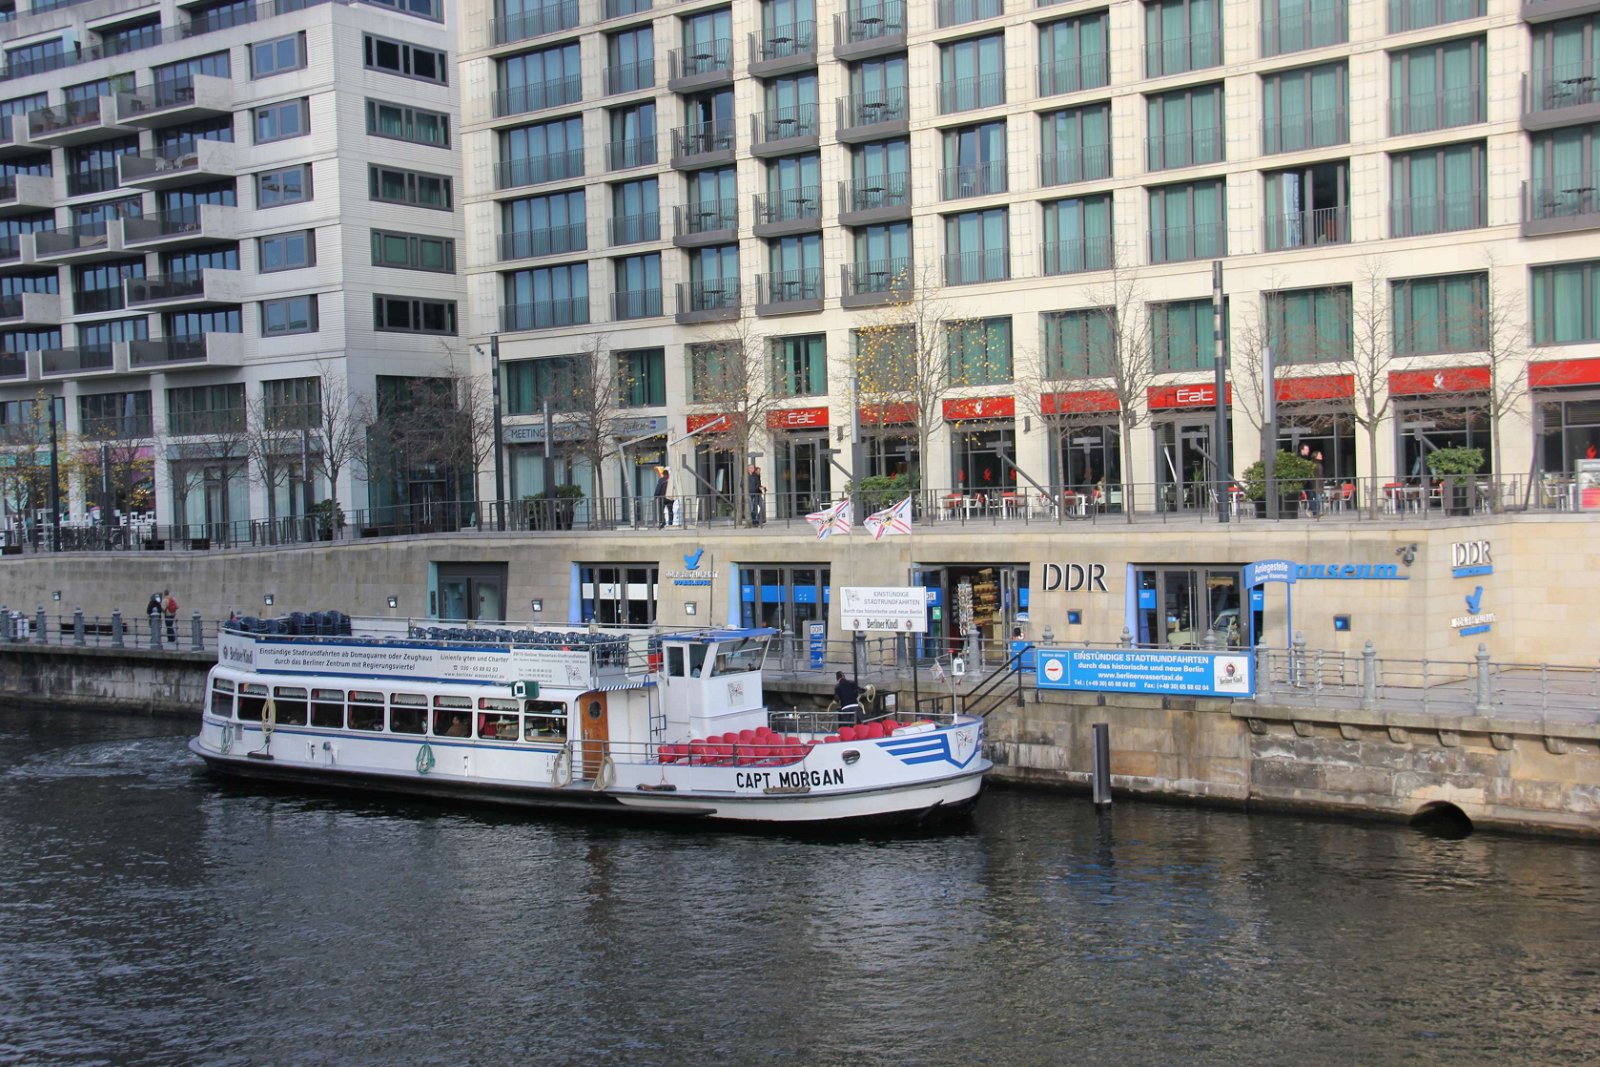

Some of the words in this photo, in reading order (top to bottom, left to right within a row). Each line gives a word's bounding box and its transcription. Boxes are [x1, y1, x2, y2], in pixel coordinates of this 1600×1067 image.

[1176, 388, 1214, 403] Eat
[787, 412, 816, 425] Eat
[1451, 540, 1493, 568] DDR
[1254, 562, 1289, 574] Anlegestelle
[1042, 562, 1109, 592] DDR
[866, 618, 885, 629] Berliner
[885, 618, 899, 629] Kindl
[292, 648, 341, 658] Stadtrundfahrten
[341, 651, 350, 659] ab
[388, 652, 402, 660] oder
[403, 653, 433, 662] Zeughaus
[1073, 651, 1124, 662] EINSTÜNDIGE
[1125, 653, 1209, 664] STADTRUNDFAHRTEN
[326, 659, 351, 667] Zentrum
[362, 661, 416, 671] Regierungsviertel
[1112, 663, 1149, 671] historische
[1149, 664, 1164, 672] und
[1183, 665, 1205, 673] Berlin
[1097, 672, 1184, 681] www.berlinerwassertaxi.de
[779, 767, 845, 789] MORGAN
